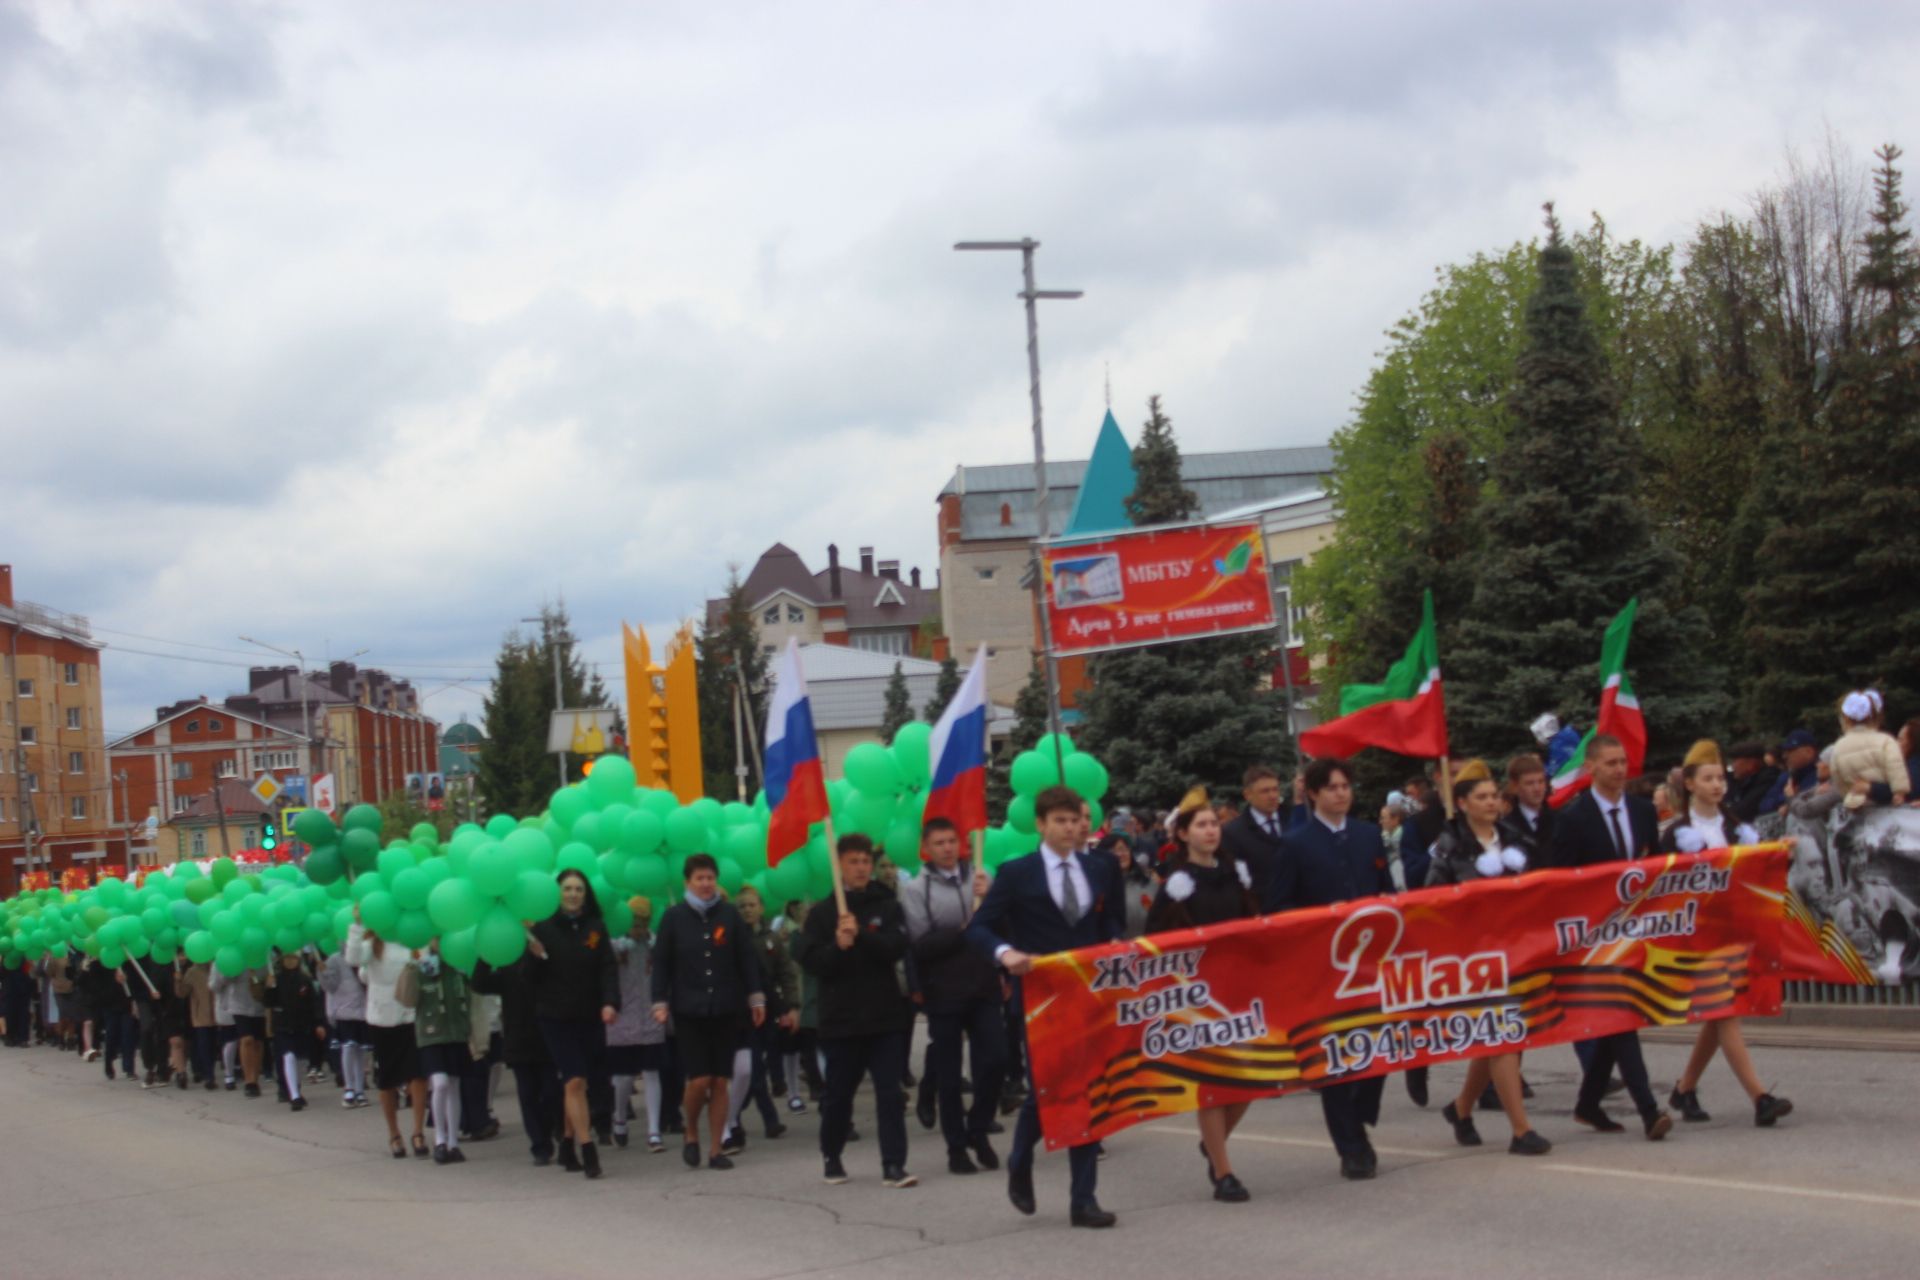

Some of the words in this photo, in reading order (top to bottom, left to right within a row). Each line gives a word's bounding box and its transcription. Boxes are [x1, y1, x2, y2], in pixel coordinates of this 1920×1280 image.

[1068, 616, 1112, 637] Арча
[1116, 609, 1128, 629] 5
[1117, 980, 1210, 1025] көне
[1380, 950, 1509, 1014] Мая
[1142, 998, 1267, 1059] белән!
[1321, 1004, 1526, 1075] 1941-1945
